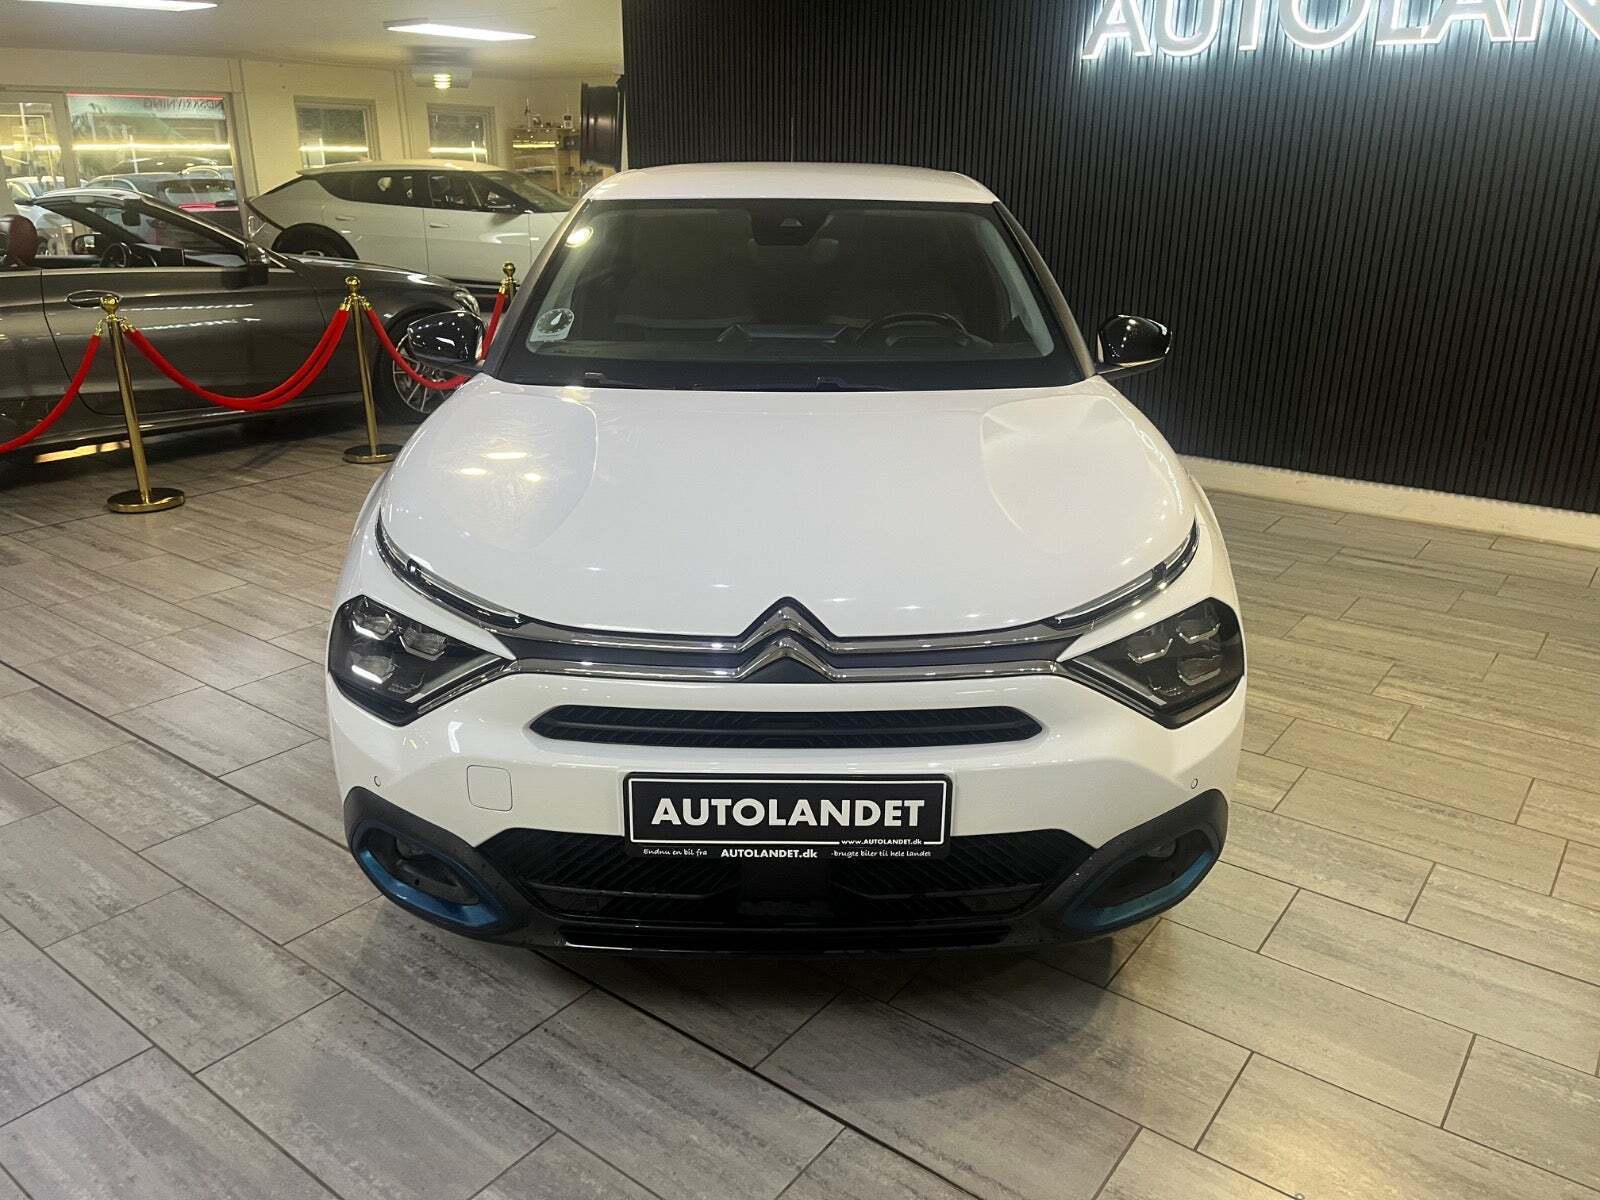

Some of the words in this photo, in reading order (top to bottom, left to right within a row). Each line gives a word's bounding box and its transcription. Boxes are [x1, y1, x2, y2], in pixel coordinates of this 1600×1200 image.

[651, 798, 925, 827] AUTOLANDET
[683, 848, 695, 856] bil
[696, 848, 708, 857] fra
[720, 848, 818, 858] AUTOLANDET.dk
[860, 849, 878, 857] biler
[879, 849, 889, 857] til
[890, 849, 905, 857] hele
[906, 849, 932, 857] landet
